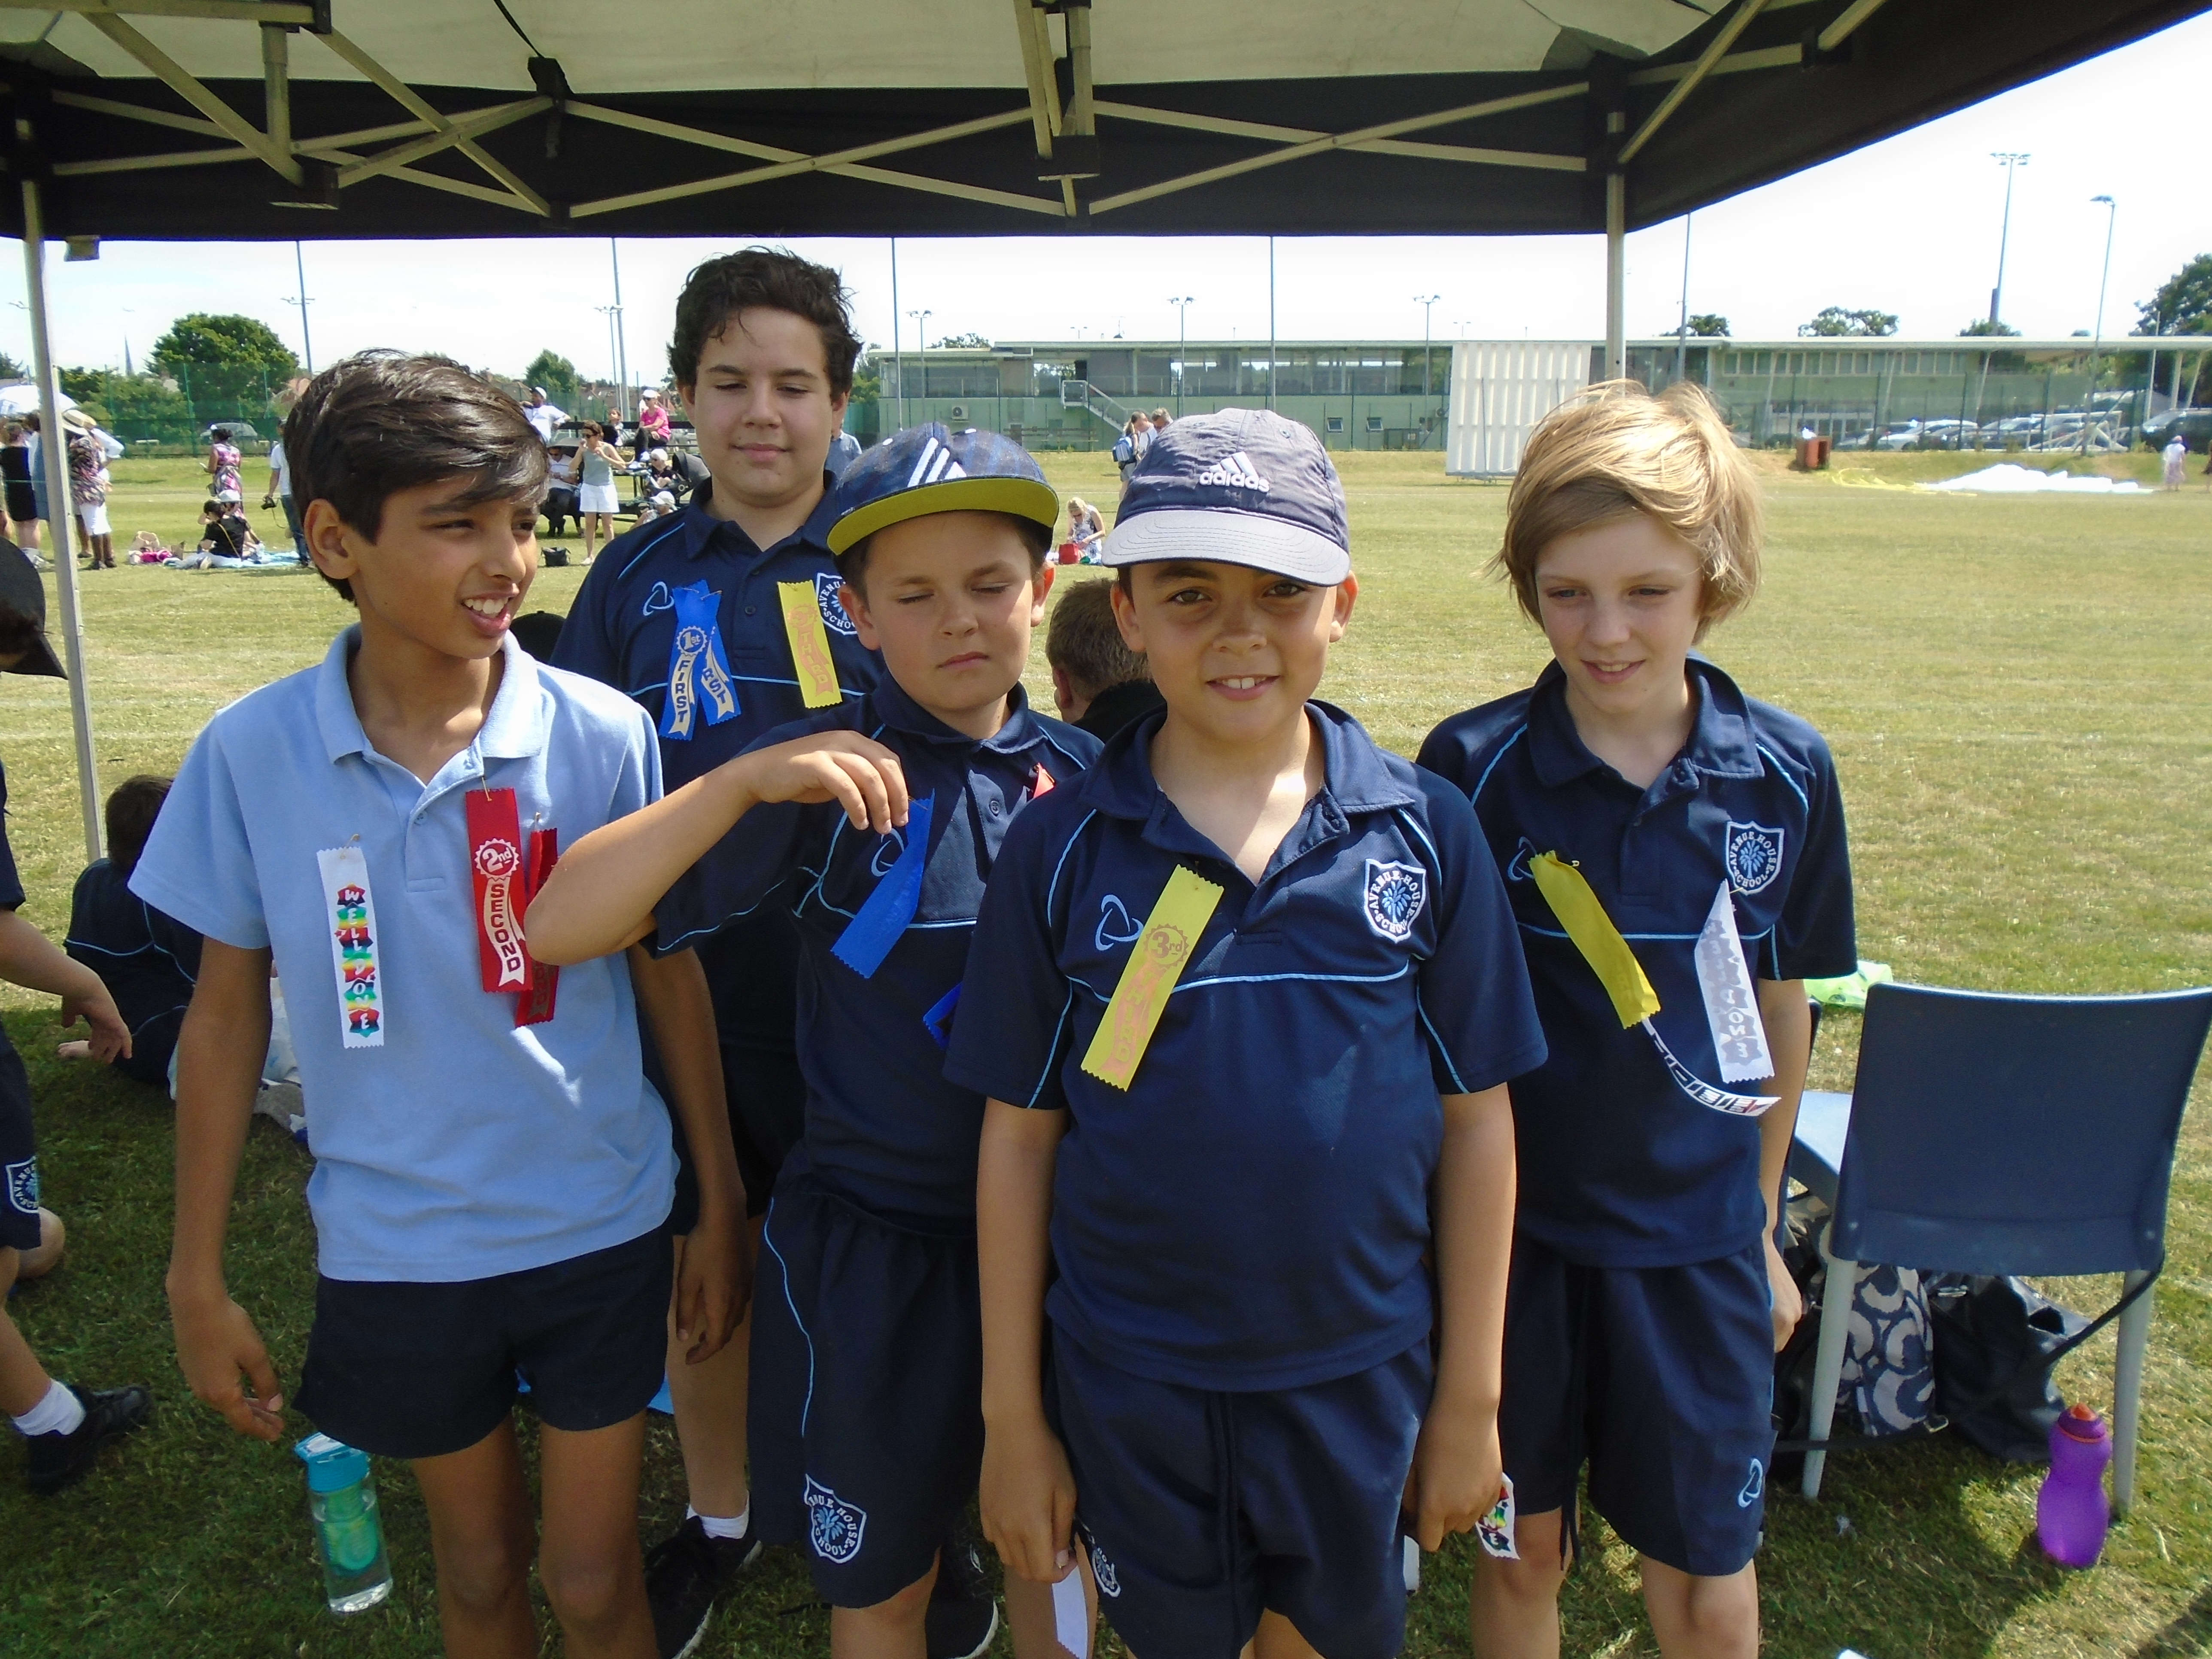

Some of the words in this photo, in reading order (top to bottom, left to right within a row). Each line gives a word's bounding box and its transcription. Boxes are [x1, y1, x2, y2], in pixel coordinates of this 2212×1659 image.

[1199, 470, 1270, 492] adidas
[819, 581, 841, 607] AVENU
[823, 611, 855, 629] SCHO
[682, 632, 701, 650] 1st
[800, 632, 829, 684] THIRD
[675, 660, 690, 723] FIRST
[702, 668, 726, 704] RST
[482, 846, 513, 872] 2nd
[1730, 831, 1755, 865] AVENUE
[1756, 834, 1776, 871] HOUSE
[1369, 870, 1400, 909] AVENUE
[1403, 874, 1421, 916] HOUSE
[1734, 869, 1768, 887] SCHOOL
[345, 889, 362, 951] WELL
[490, 884, 521, 972] SECOND
[1375, 913, 1408, 934] SCHOOL
[1150, 931, 1183, 959] 3rd
[353, 958, 370, 1029] DONE
[1116, 969, 1156, 1062] THIRD
[836, 1507, 857, 1547] HOUSE
